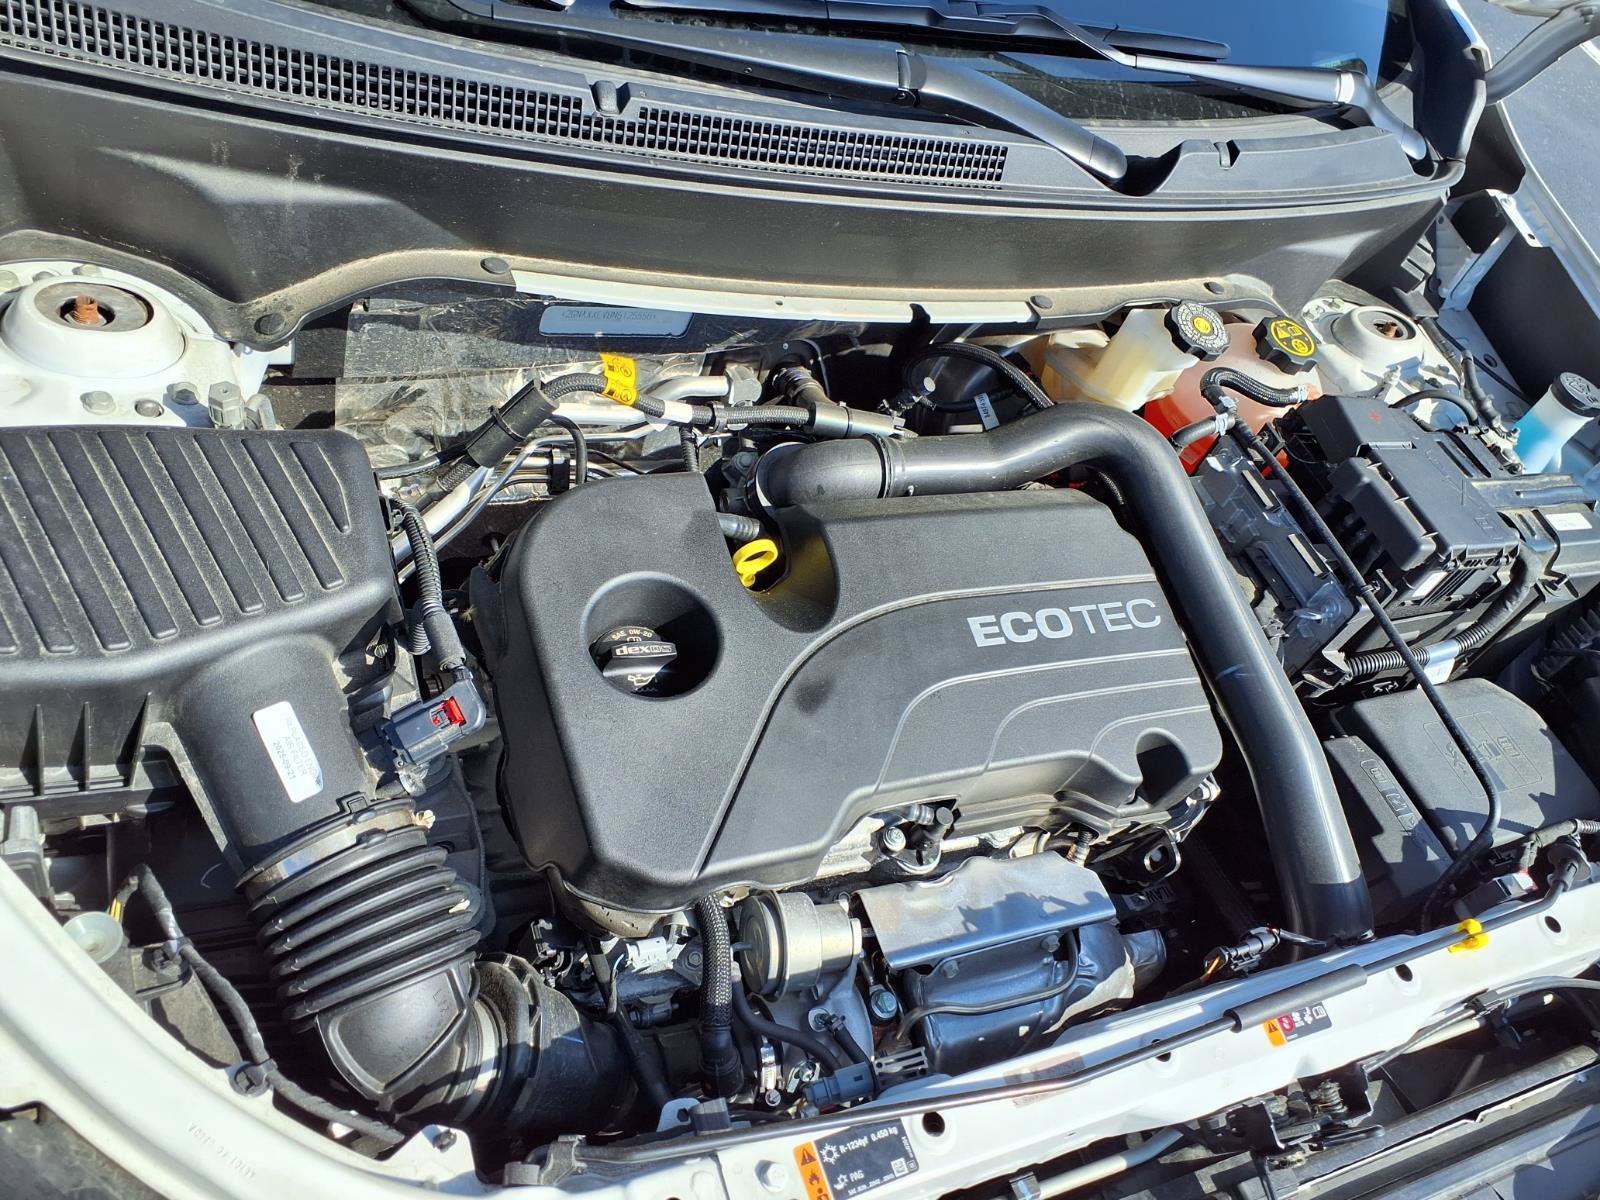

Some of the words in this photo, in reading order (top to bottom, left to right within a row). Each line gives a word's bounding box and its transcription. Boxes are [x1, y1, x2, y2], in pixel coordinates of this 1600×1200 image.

[966, 598, 1162, 648] ECOTEC
[611, 630, 627, 641] SAE
[615, 645, 672, 656] dexos
[887, 1126, 899, 1136] kg
[849, 1170, 864, 1182] PAG
